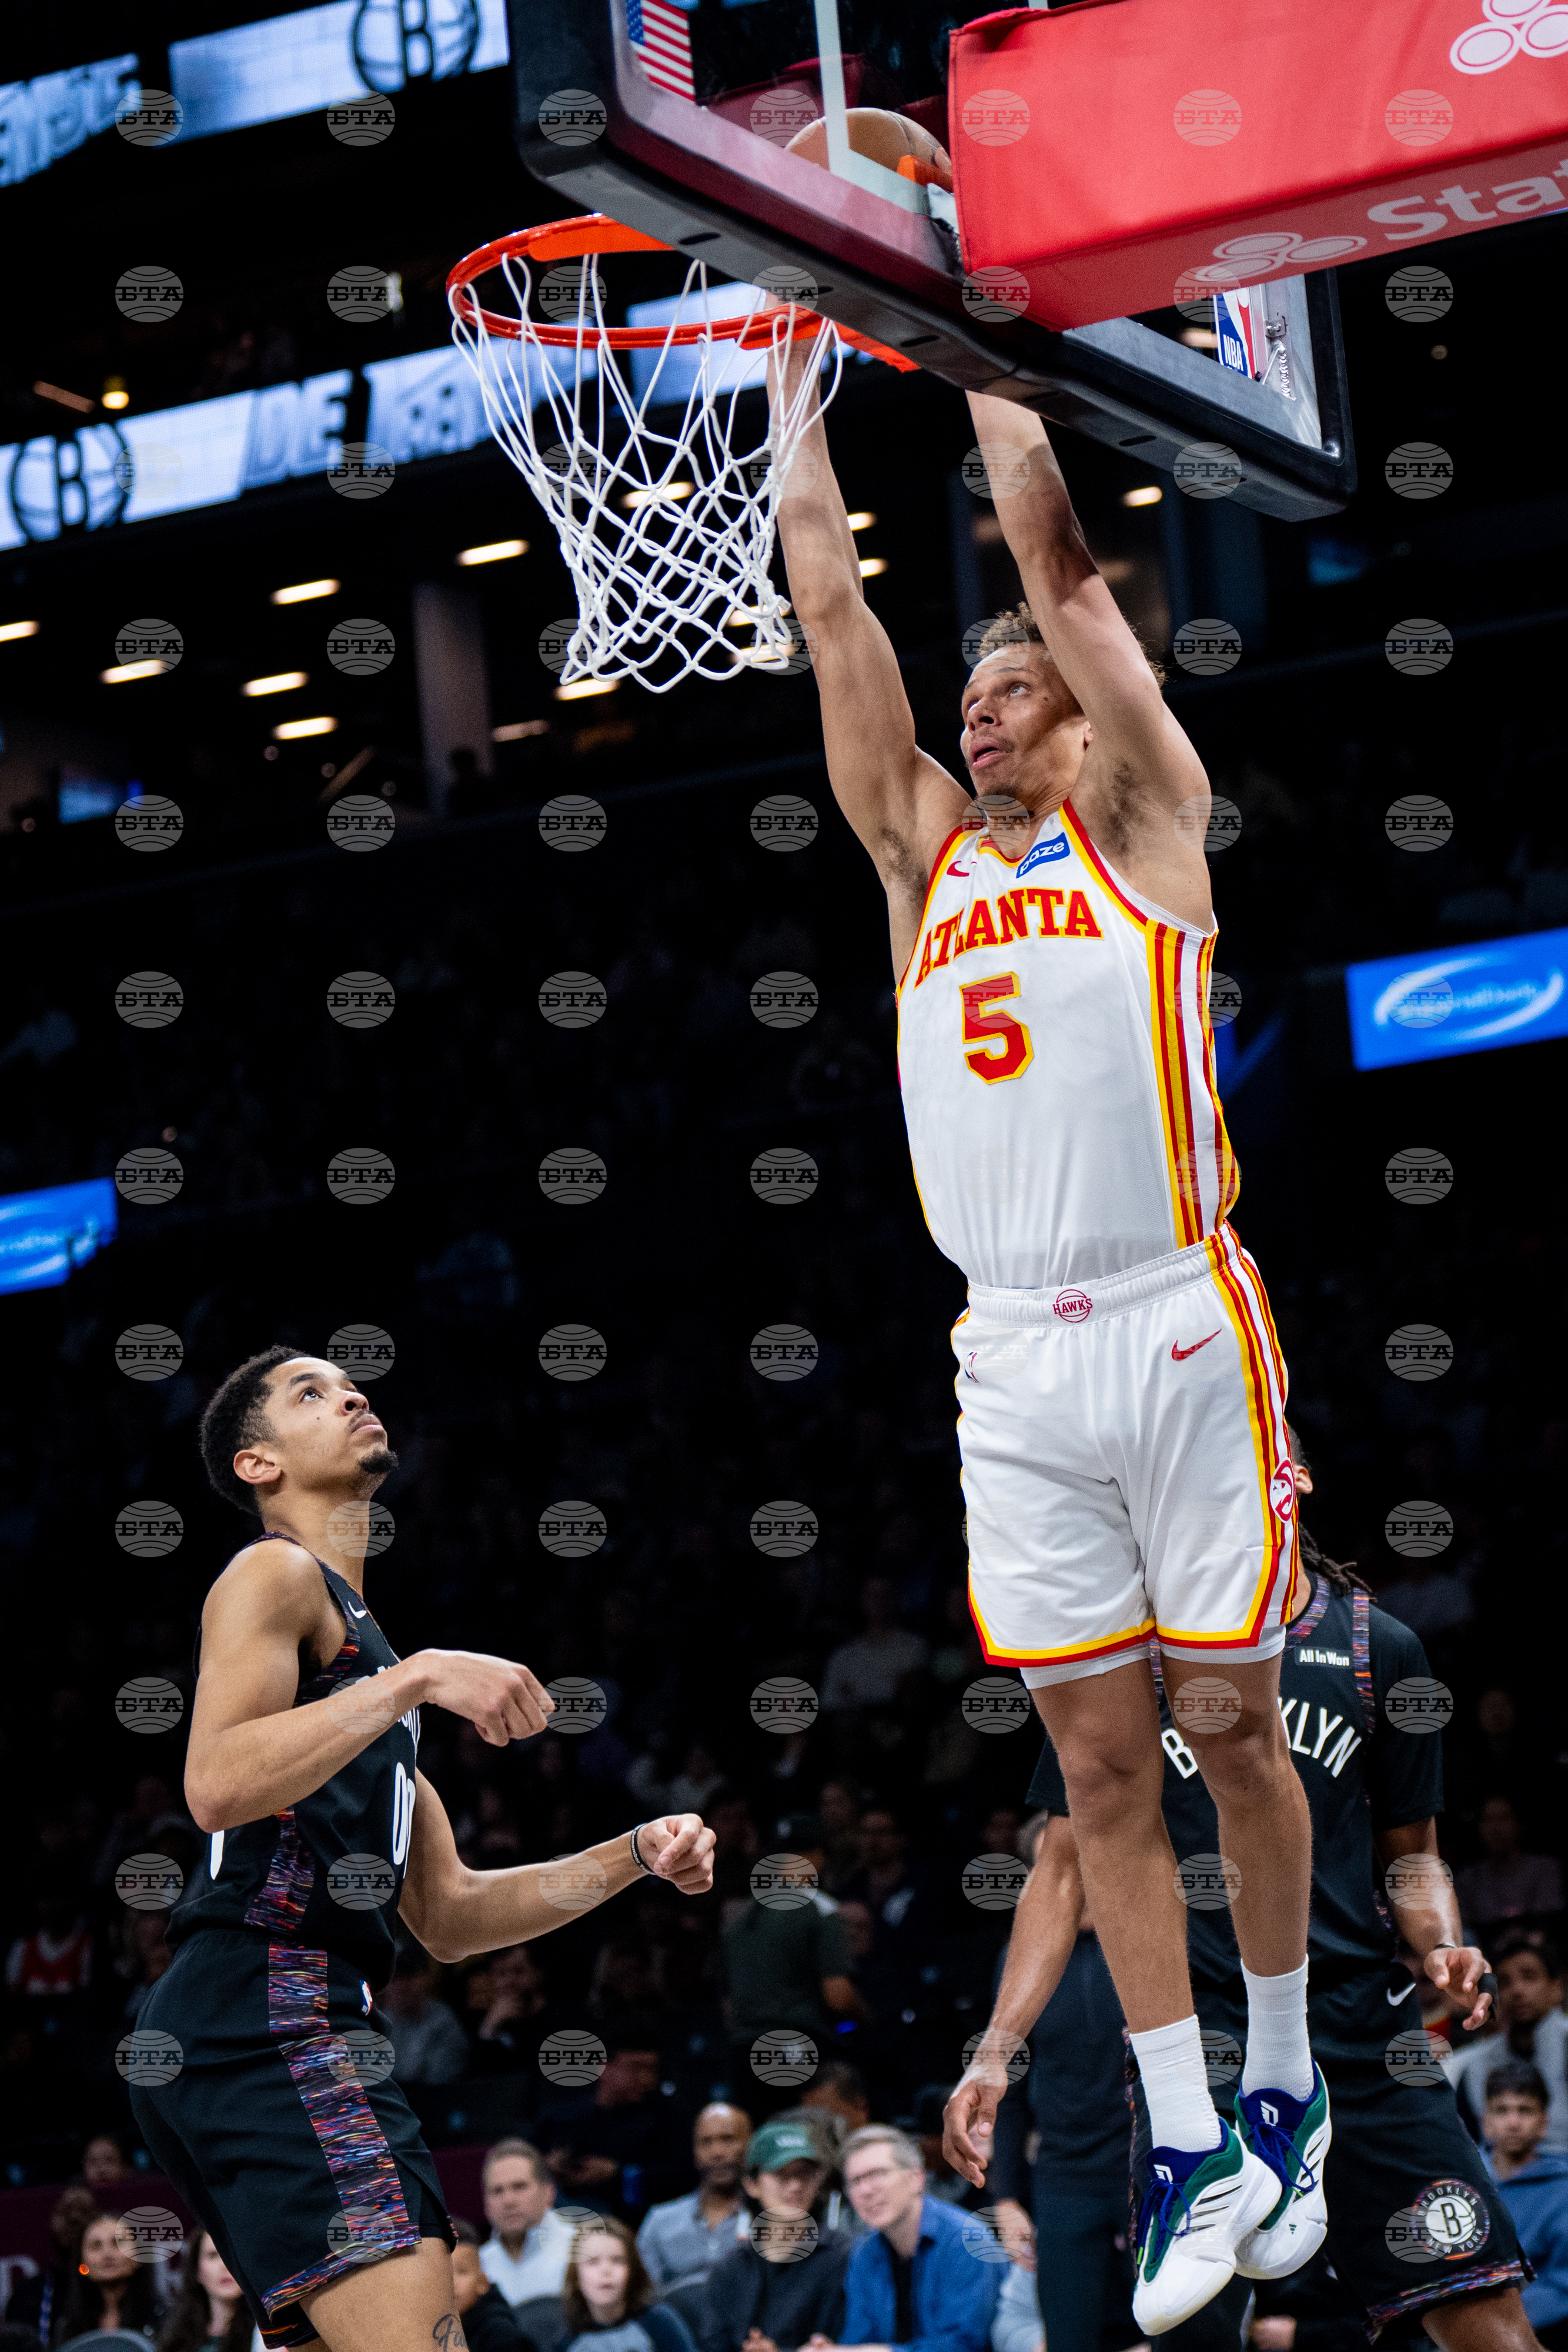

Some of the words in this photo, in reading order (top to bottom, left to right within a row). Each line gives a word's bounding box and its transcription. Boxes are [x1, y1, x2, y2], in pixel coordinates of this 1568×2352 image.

[1367, 159, 1568, 240] Sta
[1223, 333, 1244, 372] NBA
[1019, 841, 1065, 875] paze
[913, 887, 1105, 992] ATLANTA
[958, 970, 1035, 1085] 5
[1052, 1298, 1093, 1315] HAWKS
[1299, 1649, 1314, 1663] All
[1315, 1649, 1326, 1663] In
[1326, 1651, 1350, 1666] Won
[1161, 1696, 1362, 1779] BKLYN
[1417, 2186, 1477, 2216] BROOKLYN
[1440, 2202, 1462, 2239] B
[1427, 2237, 1453, 2254] NEW
[1458, 2229, 1483, 2252] YORK
